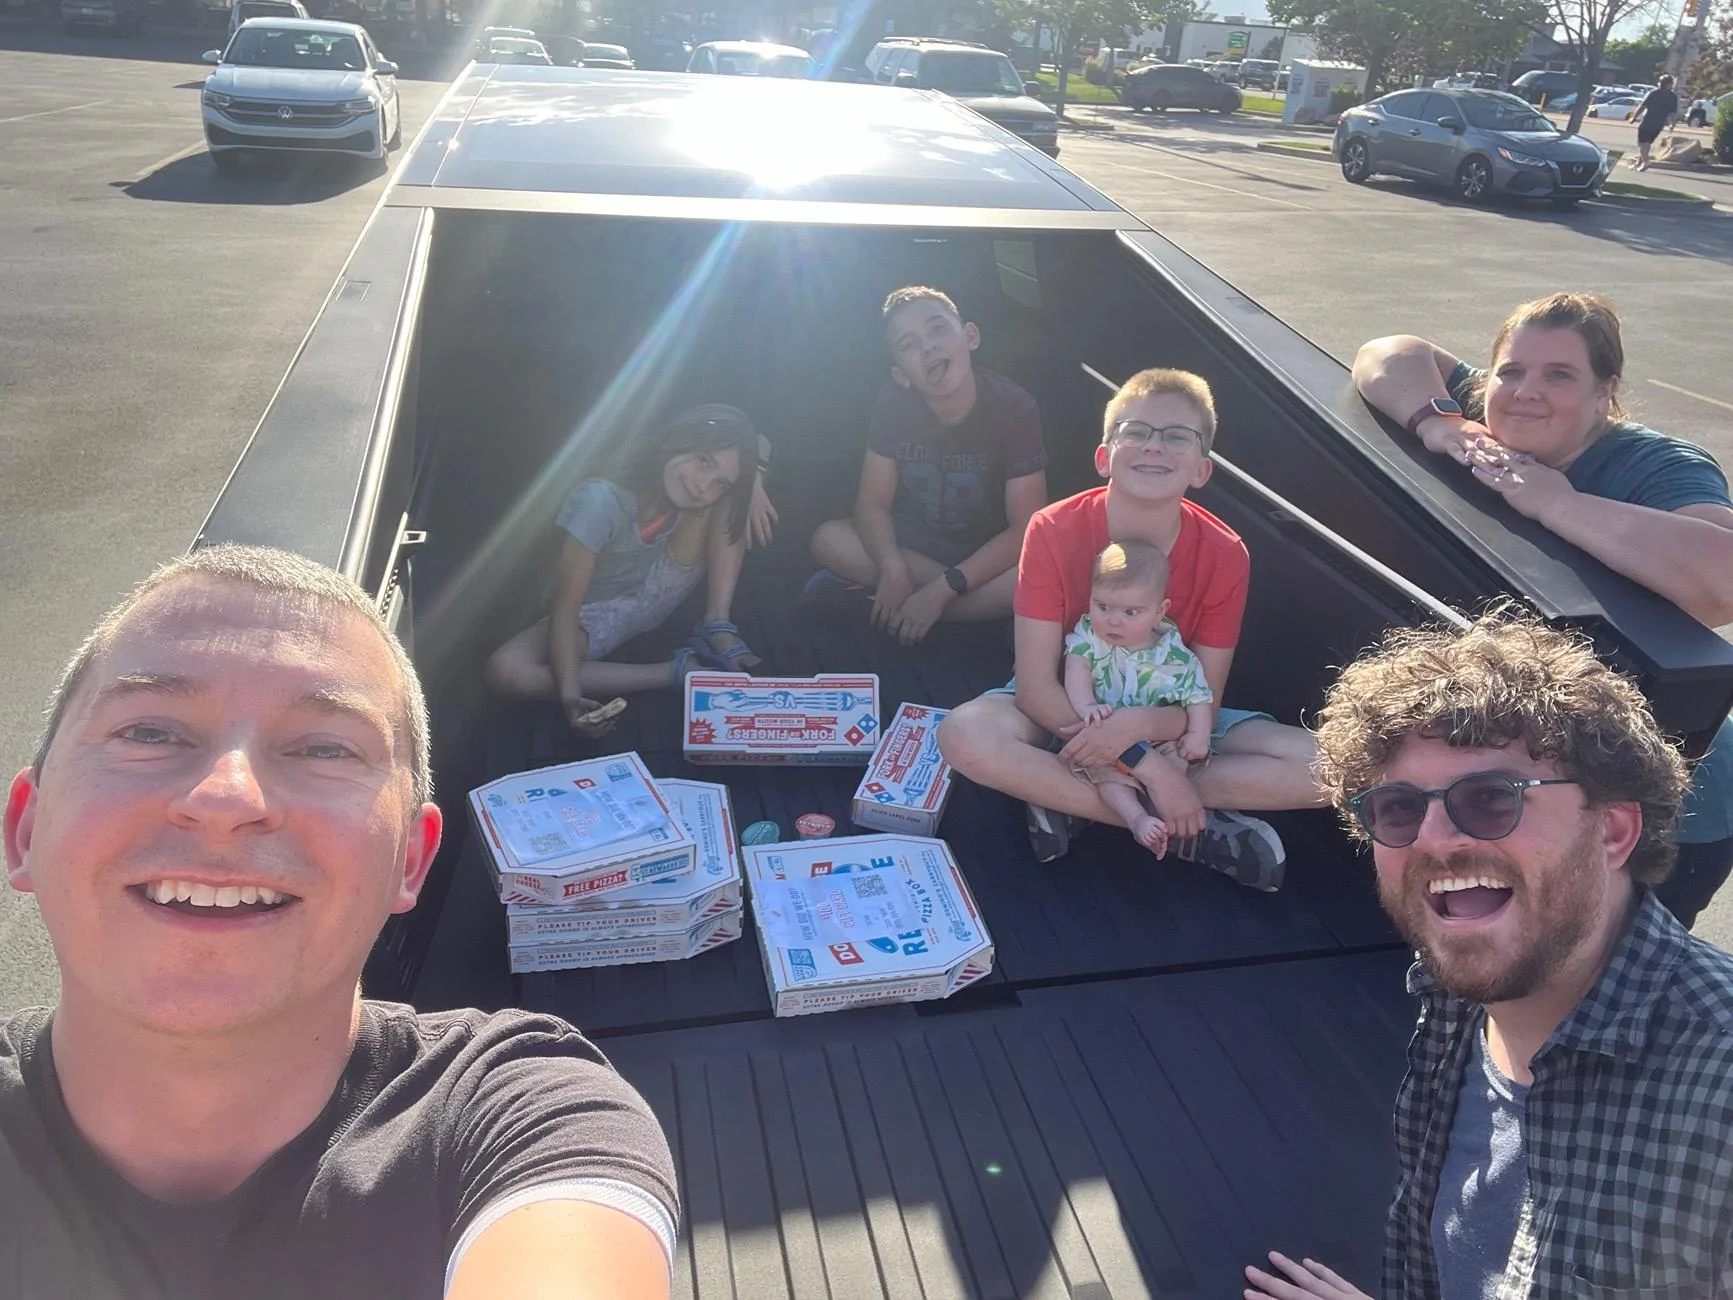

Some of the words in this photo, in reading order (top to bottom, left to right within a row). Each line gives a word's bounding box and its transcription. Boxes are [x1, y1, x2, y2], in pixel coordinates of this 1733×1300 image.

[726, 728, 790, 740] FINGERS?
[803, 729, 836, 740] FORK
[876, 760, 894, 780] FORK
[568, 882, 591, 895] FREE
[593, 872, 623, 890] PIZZA?
[904, 878, 927, 895] BOX
[792, 900, 803, 912] WE
[921, 896, 933, 924] PIZZA
[538, 922, 572, 930] PLEASE
[796, 912, 807, 924] DID
[841, 911, 855, 929] GIFT
[801, 926, 815, 941] HOW
[803, 996, 836, 1004] PLEASE
[886, 987, 918, 995] DRIVER
